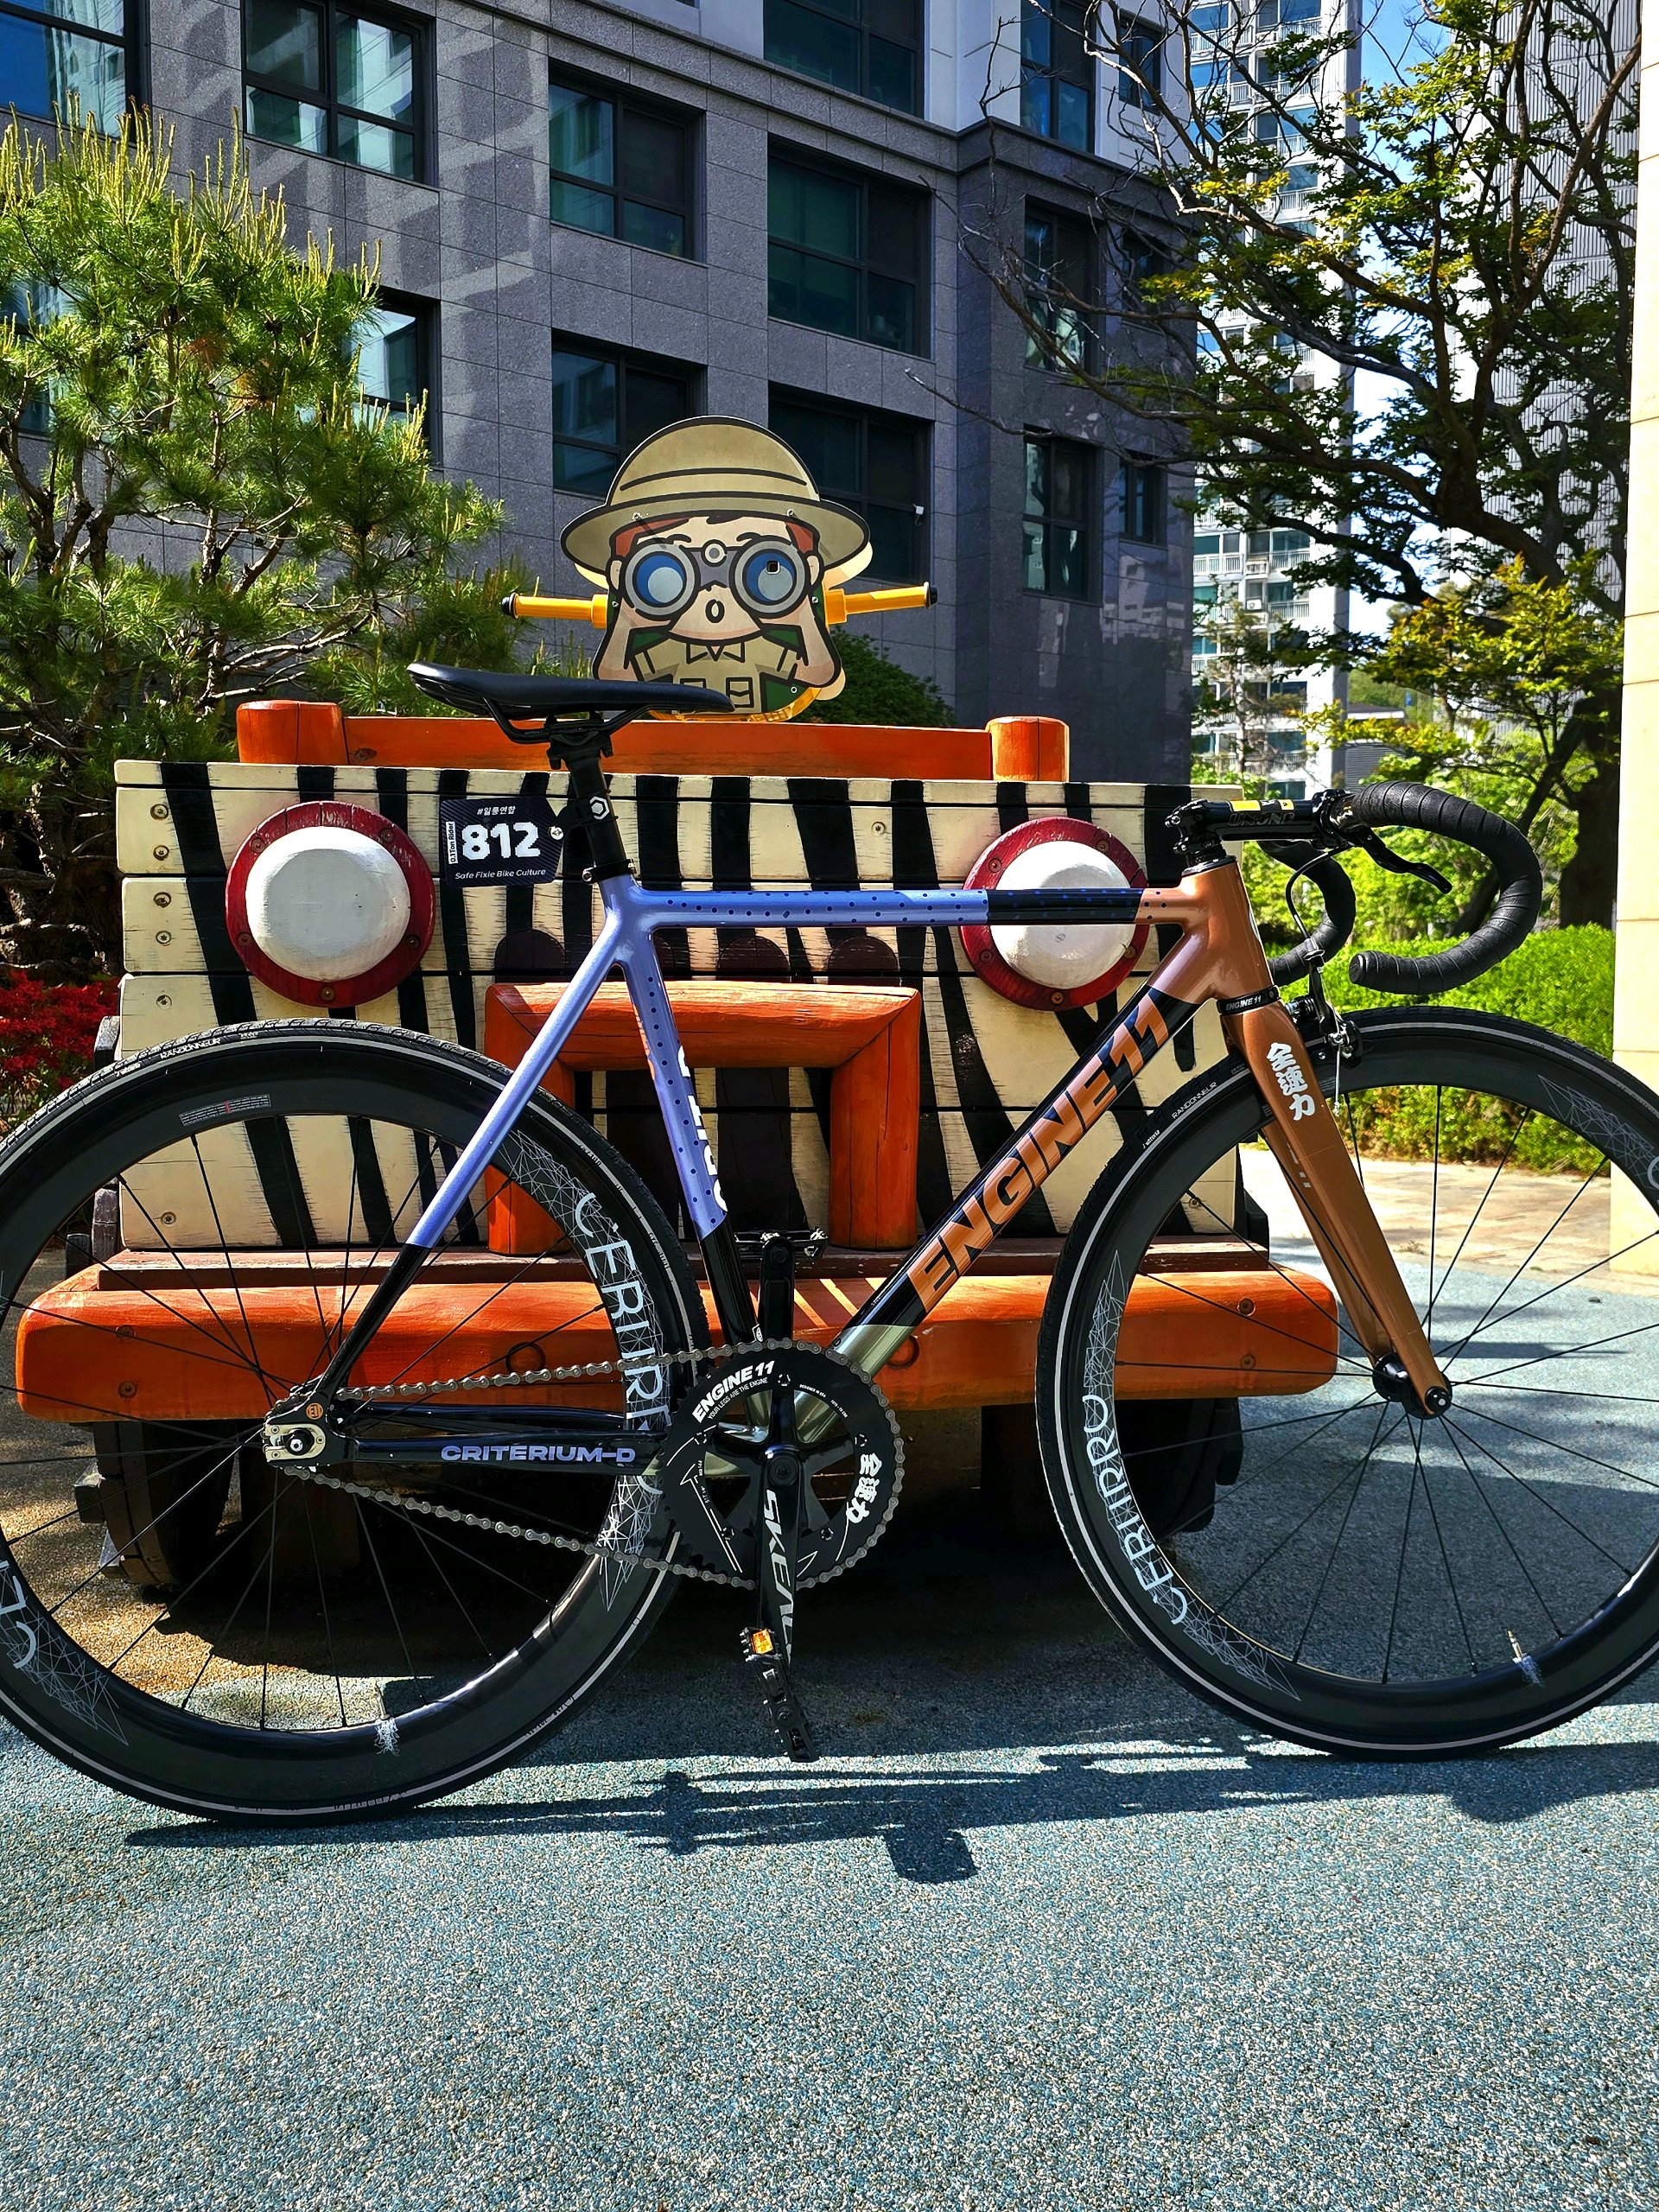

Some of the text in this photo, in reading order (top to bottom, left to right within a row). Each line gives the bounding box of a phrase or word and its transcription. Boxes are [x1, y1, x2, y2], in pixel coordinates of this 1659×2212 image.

[461, 822, 541, 861] 812
[454, 868, 546, 880] Safe Fixie Bike Culture
[1225, 995, 1262, 1011] ENGINE 11
[1171, 1081, 1217, 1119] RANDONNEUR
[691, 1360, 775, 1424] ENGINE 11
[707, 1376, 769, 1420] YOUR LEGS ARE THE ENGINE
[441, 1445, 636, 1463] CRITERIUM-D
